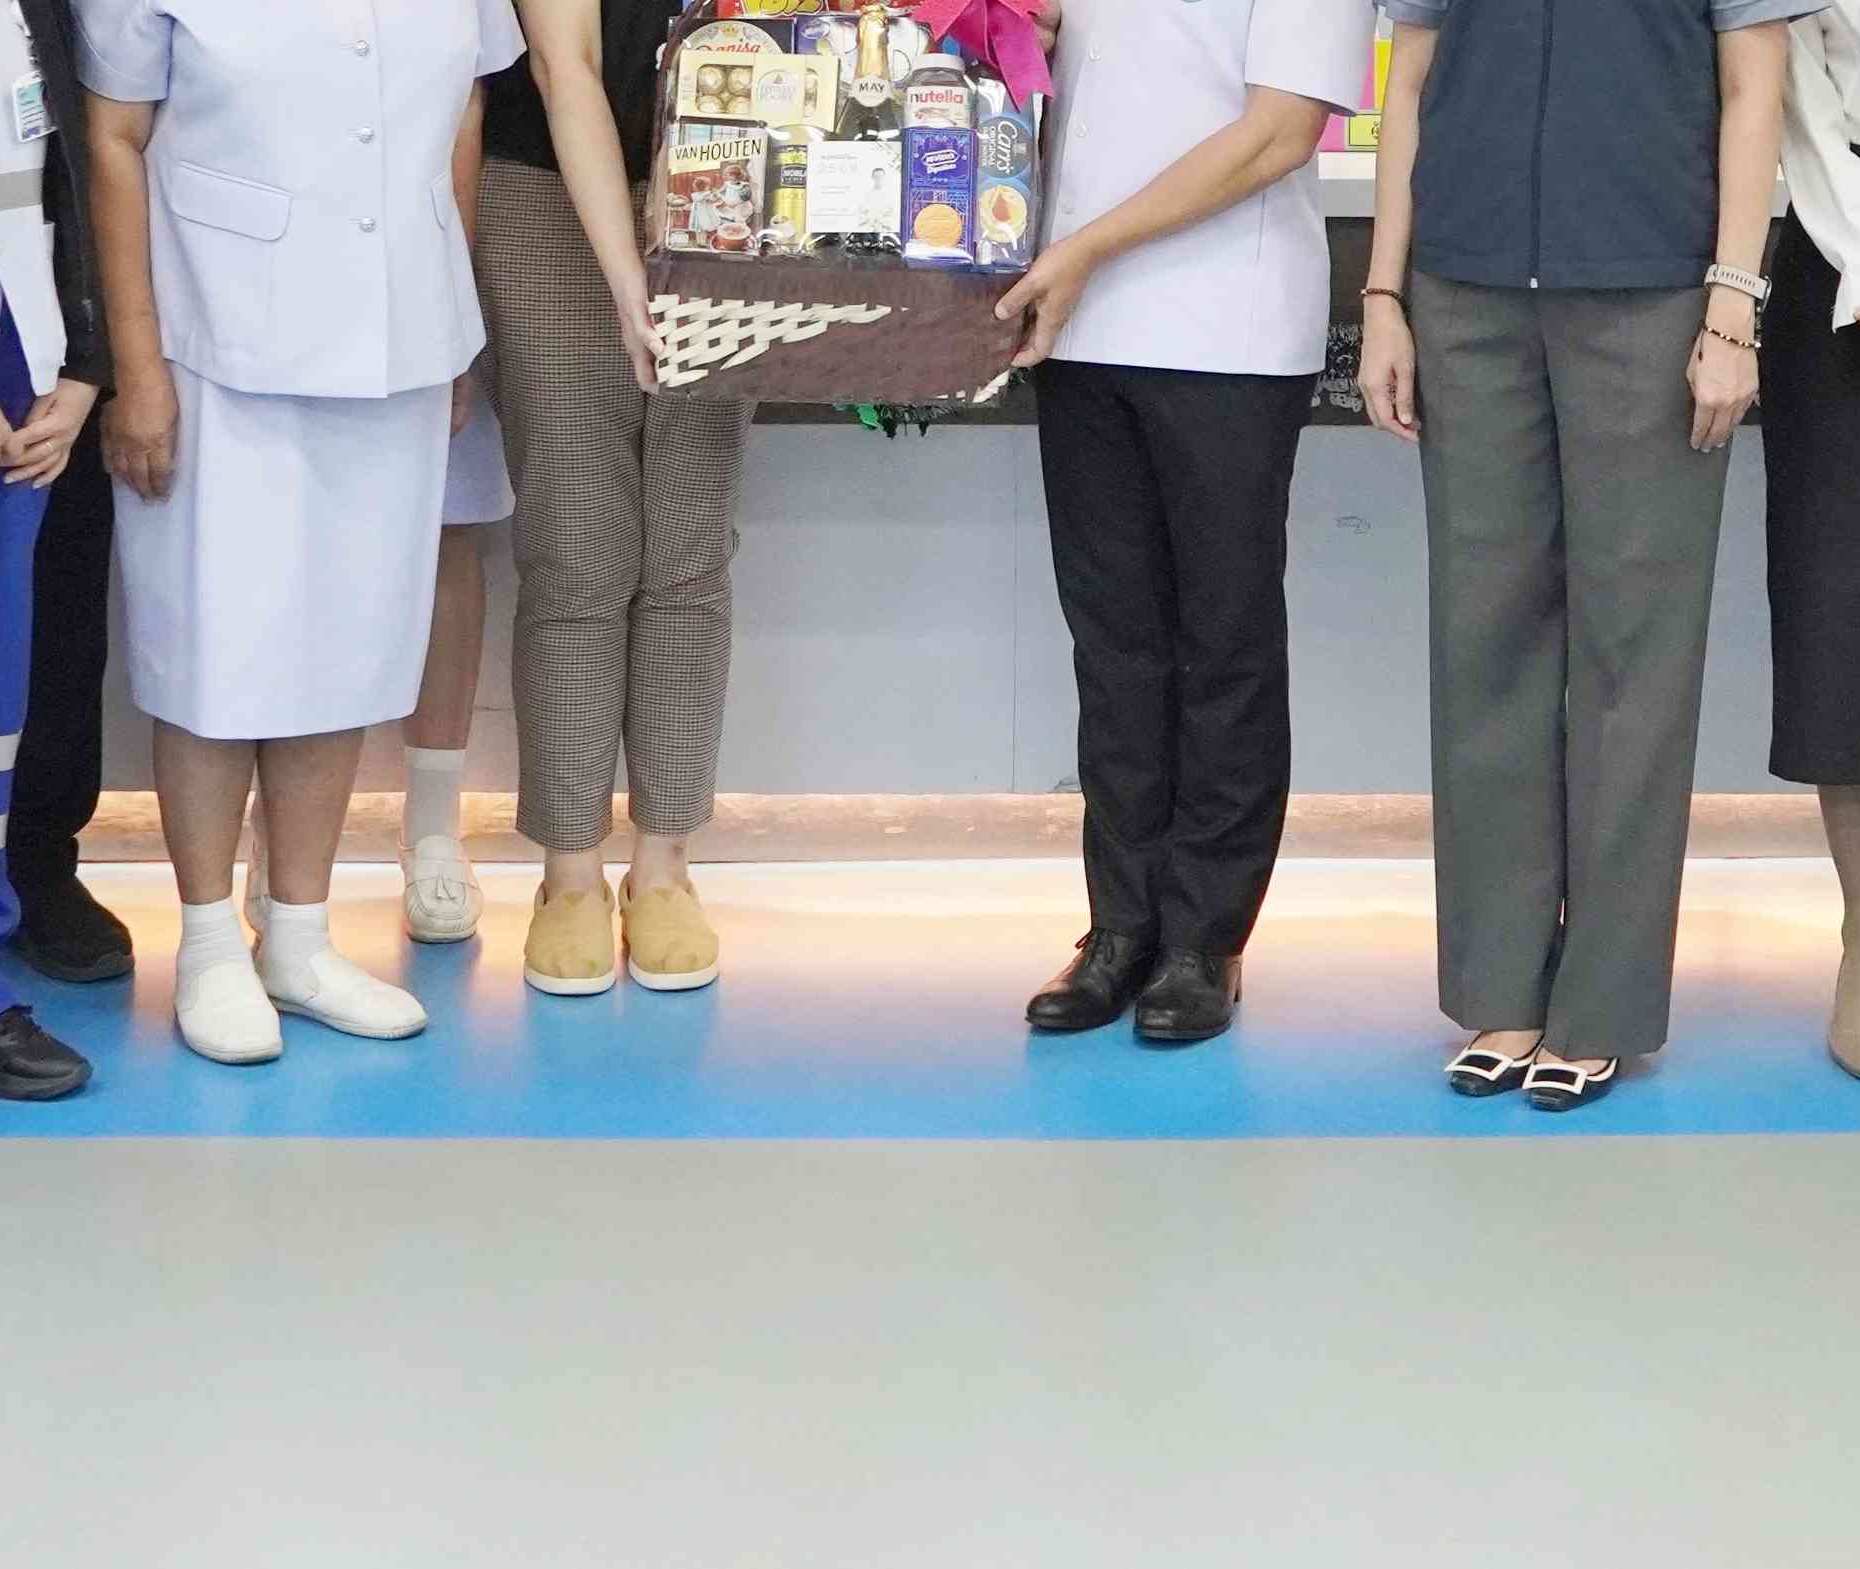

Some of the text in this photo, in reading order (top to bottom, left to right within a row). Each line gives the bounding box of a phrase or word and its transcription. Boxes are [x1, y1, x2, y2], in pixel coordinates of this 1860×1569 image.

[910, 89, 964, 104] nutella
[674, 137, 763, 162] VAN HOUTEN
